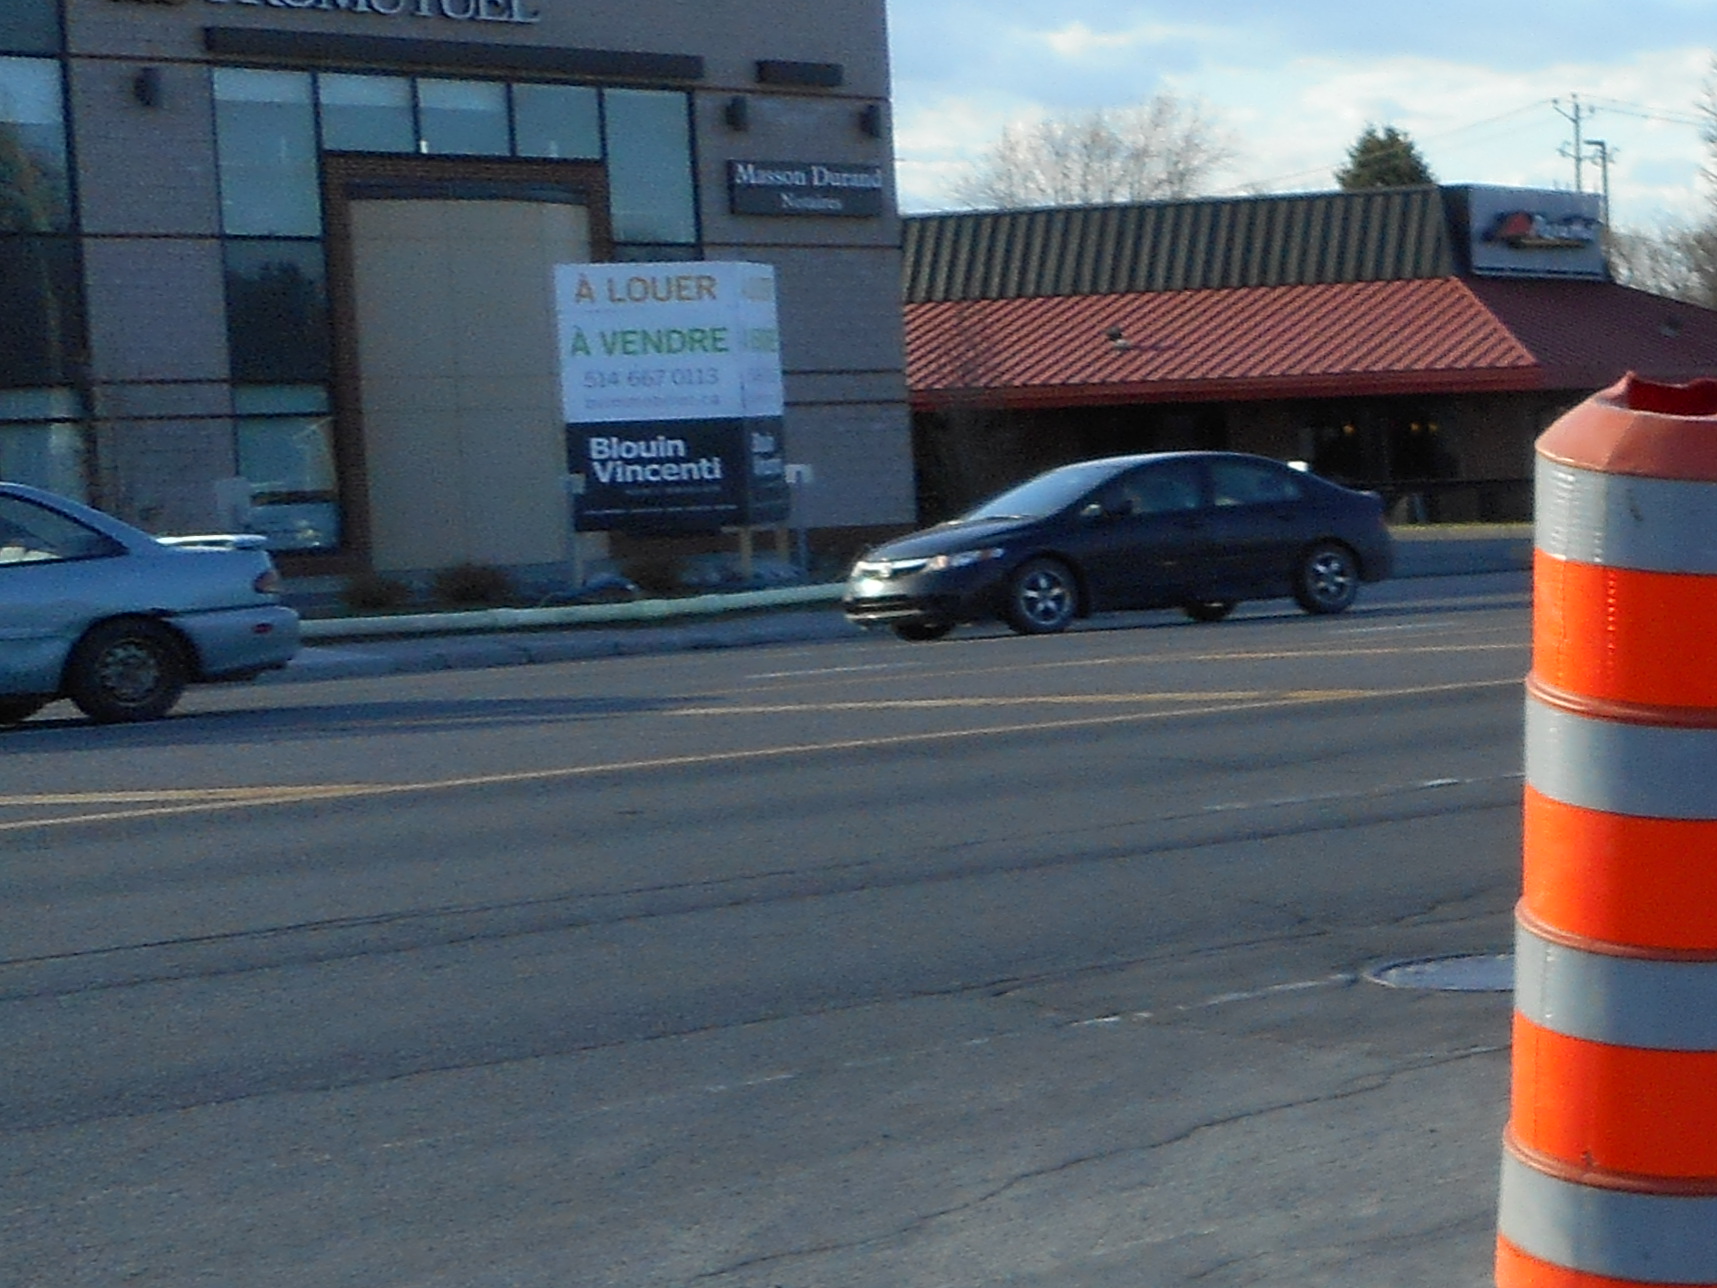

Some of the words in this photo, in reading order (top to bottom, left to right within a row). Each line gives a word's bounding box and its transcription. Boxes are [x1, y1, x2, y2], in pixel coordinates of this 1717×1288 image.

[735, 163, 806, 187] Masson
[811, 164, 882, 188] Durand
[575, 273, 594, 303] À
[607, 275, 718, 303] LOUER
[571, 324, 591, 357] À
[599, 327, 730, 356] VENDRE
[583, 370, 619, 389] 514
[589, 435, 686, 460] Blouin
[592, 457, 723, 484] Vincenti
